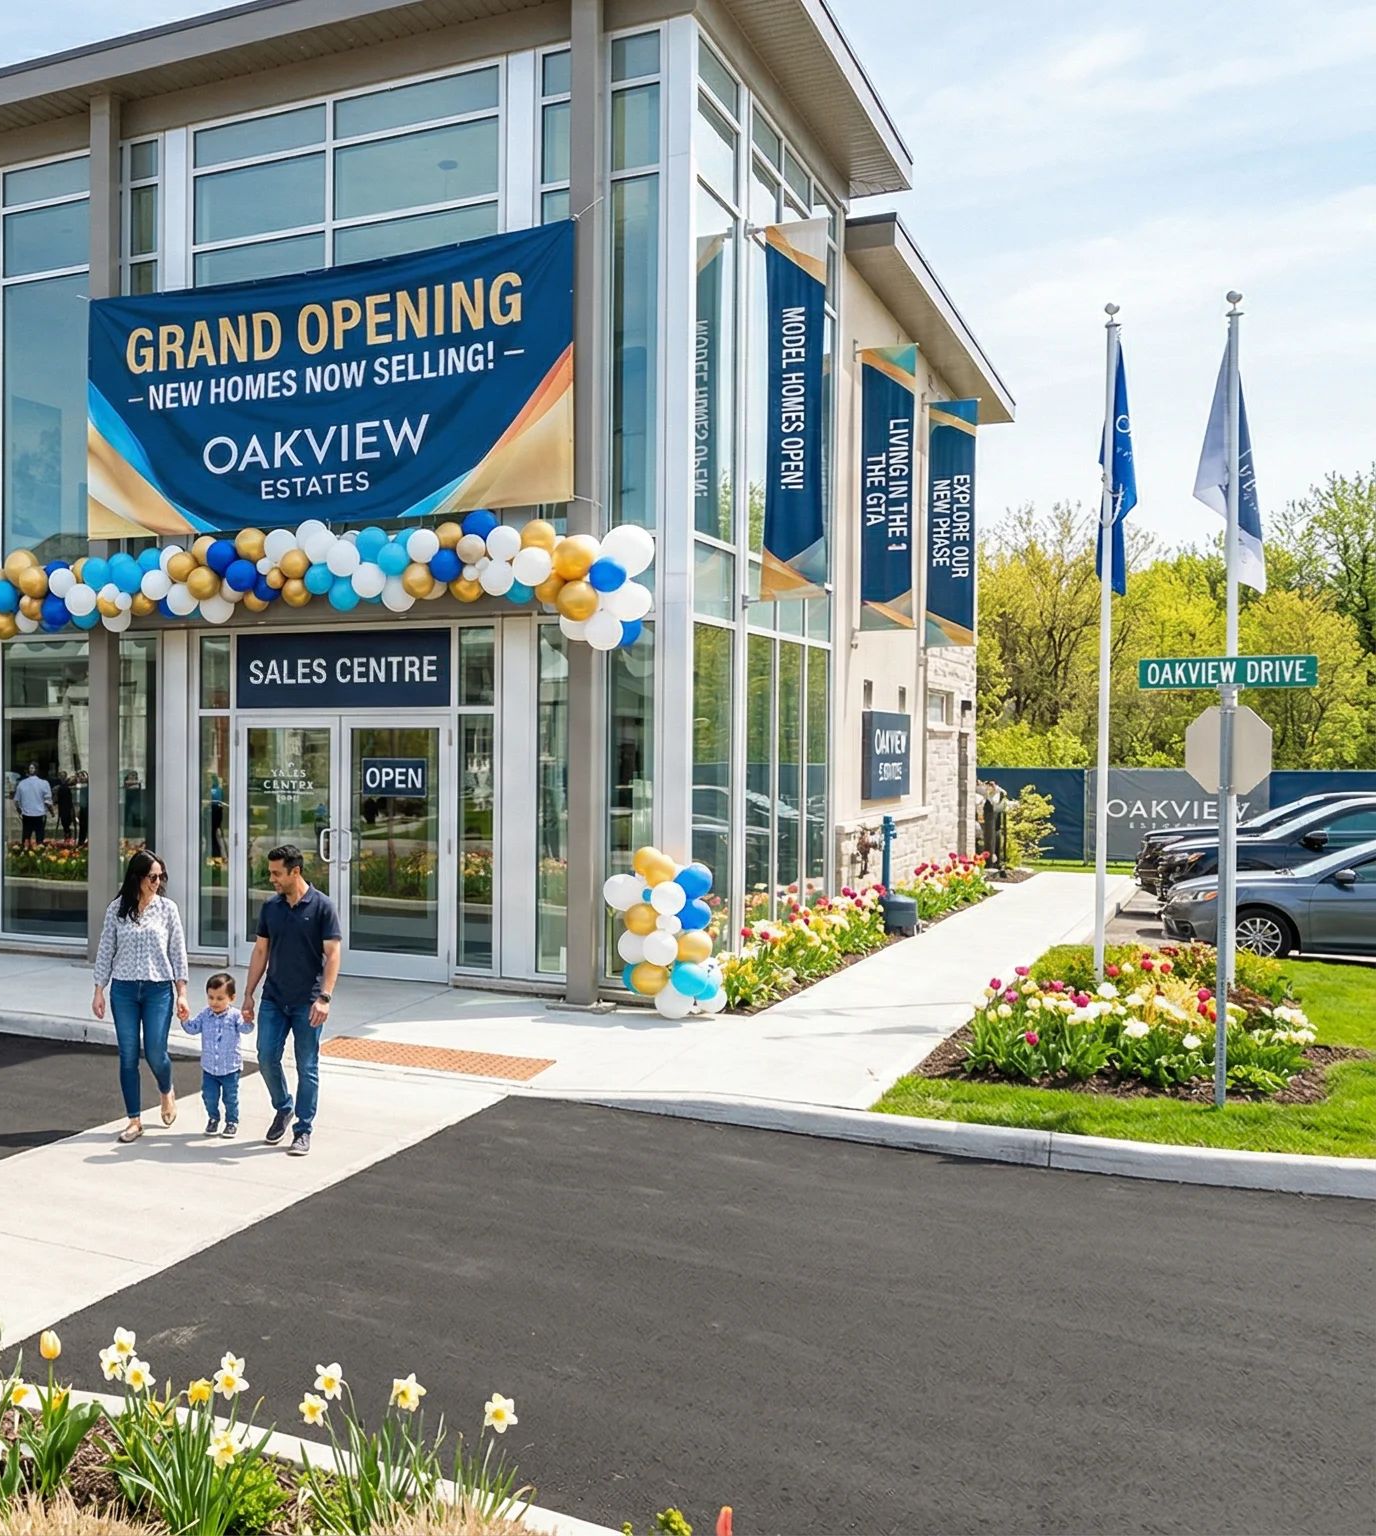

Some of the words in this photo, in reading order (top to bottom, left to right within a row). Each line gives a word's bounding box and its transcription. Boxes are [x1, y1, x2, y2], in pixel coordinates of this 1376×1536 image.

[126, 311, 282, 375] GRAND
[297, 271, 523, 355] OPENING
[782, 306, 805, 369] MODEL
[148, 380, 203, 411] NEW
[209, 369, 297, 404] HOMES
[305, 360, 365, 394] NOW
[373, 340, 495, 386] SELLING!
[781, 372, 805, 433] HOMES
[202, 413, 430, 475] OAKVIEW
[888, 418, 909, 477] LIVING
[781, 437, 804, 490] OPEN!
[866, 452, 886, 488] THE
[260, 470, 370, 499] ESTATES
[888, 480, 908, 499] IN
[933, 479, 951, 514] NEW
[866, 493, 886, 527] GTA
[888, 502, 908, 538] THE
[952, 474, 970, 542] EXPLORE
[932, 518, 951, 568] PHASE
[951, 545, 970, 579] OUR
[249, 658, 327, 684] SALES
[335, 655, 437, 684] CENTRE
[1147, 661, 1237, 685] OAKVIEW
[1246, 659, 1307, 683] DRIVE
[365, 767, 423, 789] OPEN
